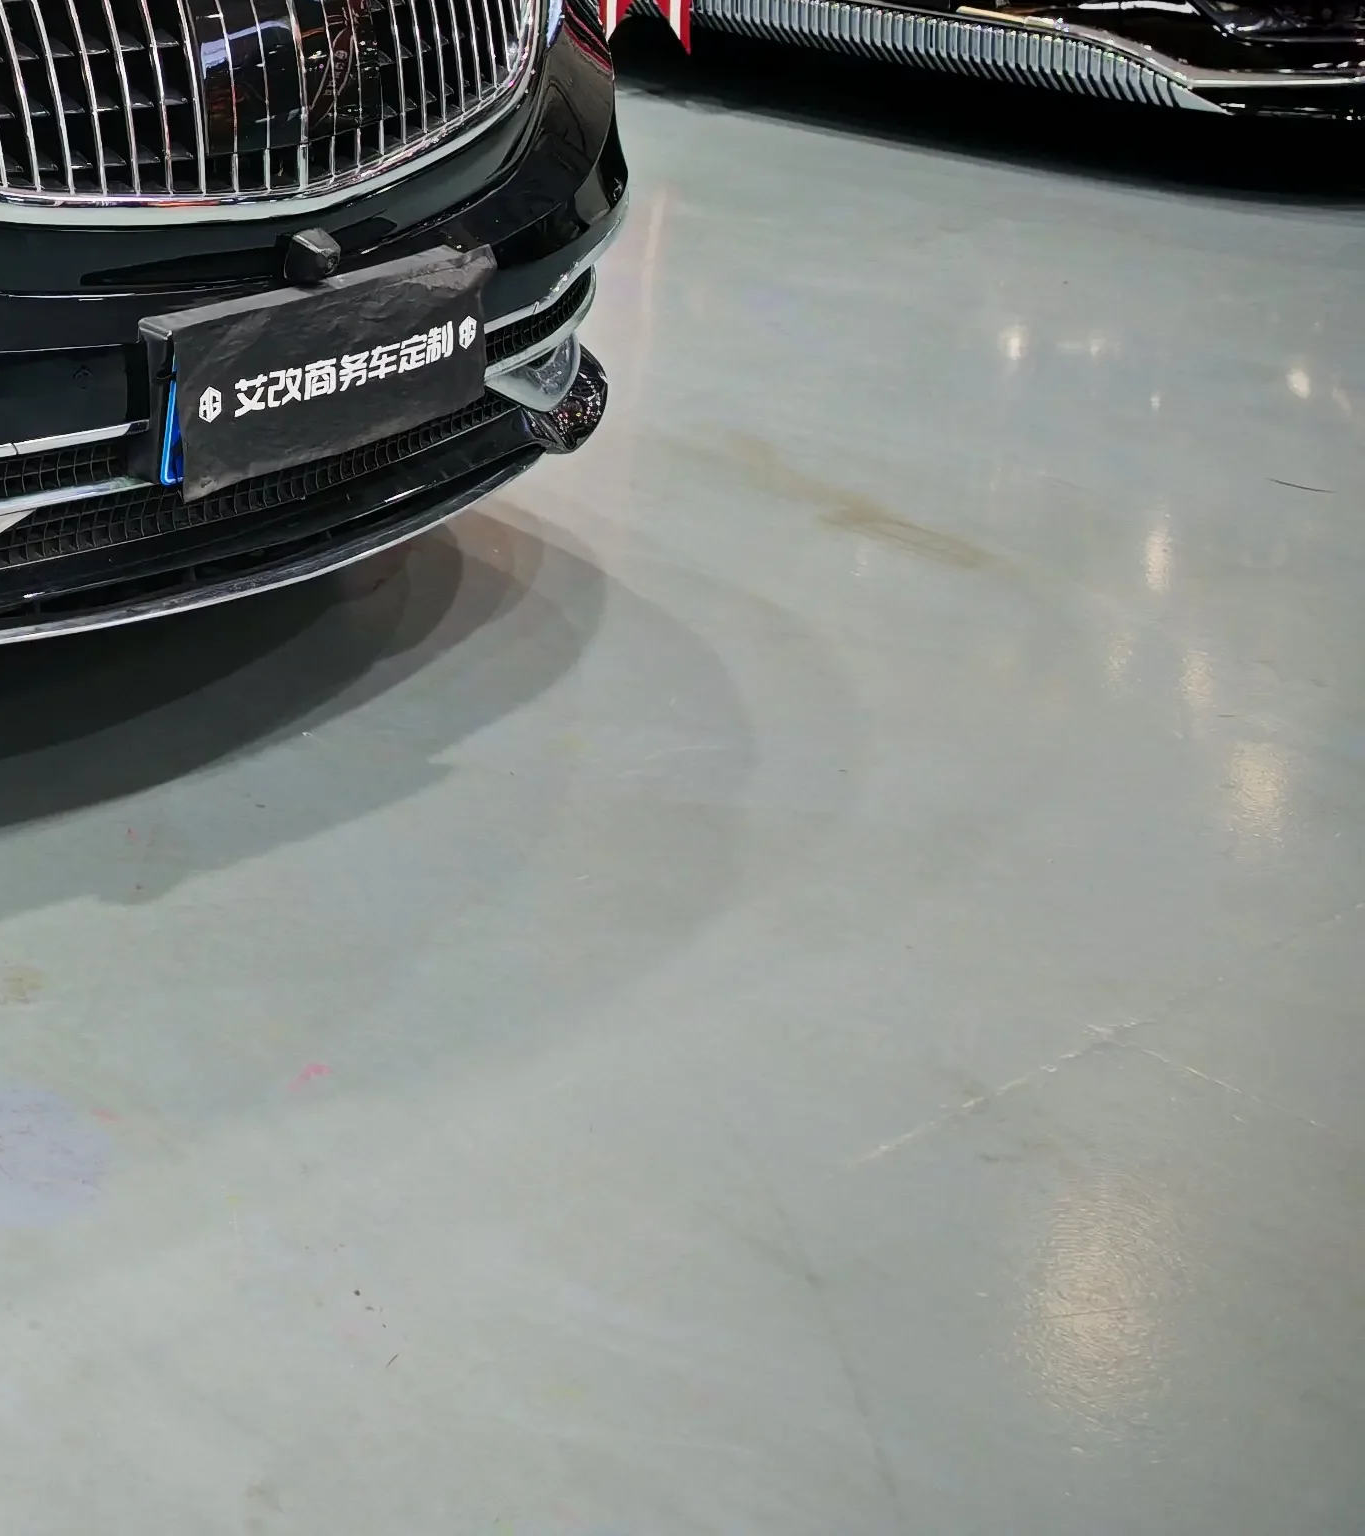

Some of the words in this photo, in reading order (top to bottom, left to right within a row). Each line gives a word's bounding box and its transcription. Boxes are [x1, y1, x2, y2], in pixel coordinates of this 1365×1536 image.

[234, 320, 454, 419] 艾改商务车定制
